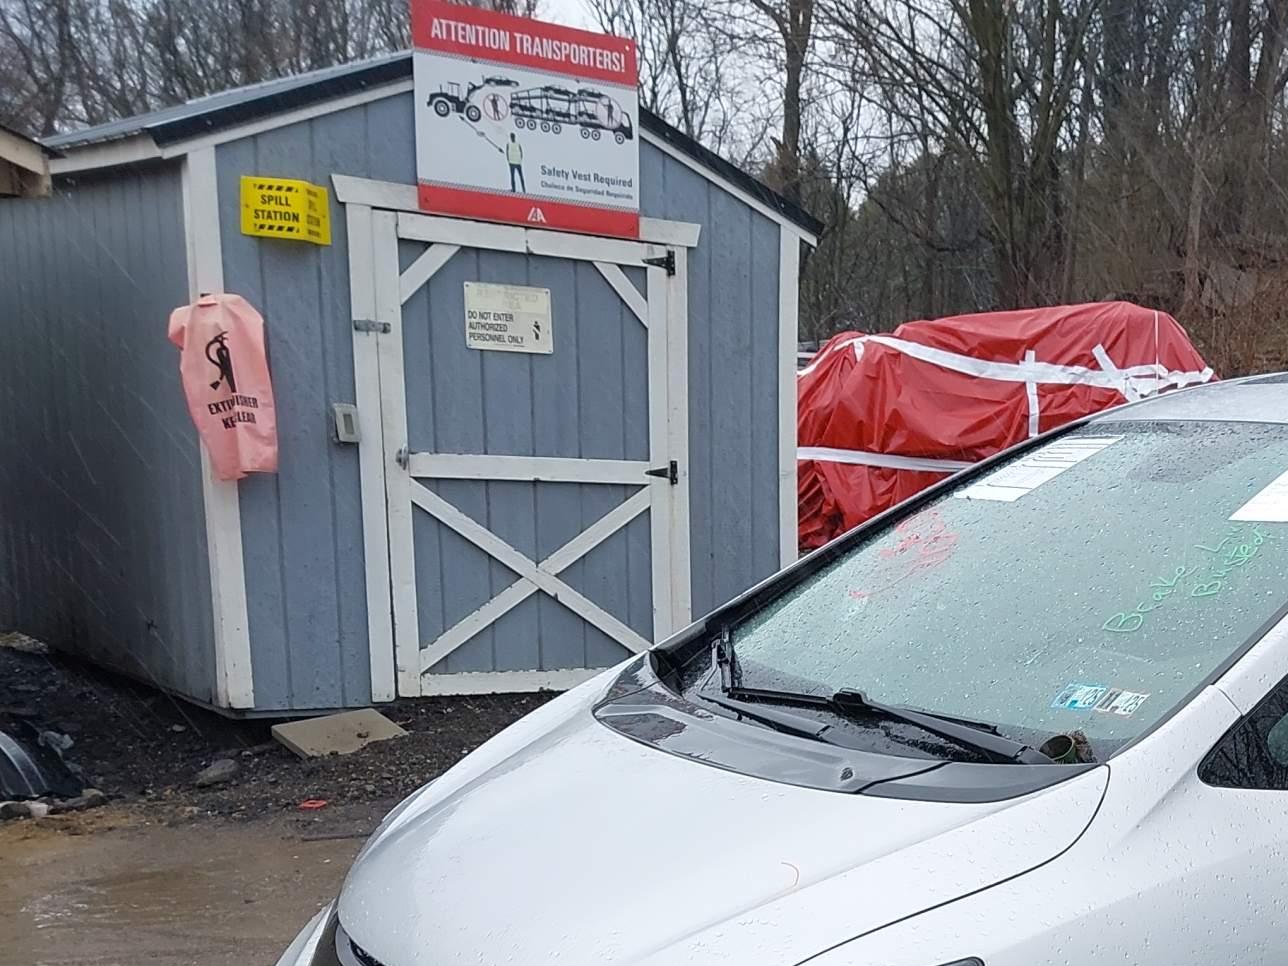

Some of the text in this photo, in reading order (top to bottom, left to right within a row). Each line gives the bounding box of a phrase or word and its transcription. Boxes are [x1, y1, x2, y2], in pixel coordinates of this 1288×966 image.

[430, 17, 626, 73] ATTENTION TRANSPORTERS!
[541, 164, 633, 188] Safety Vest Required
[260, 194, 291, 207] SPILL
[254, 208, 300, 223] STATION
[468, 310, 514, 322] DO NOT ENTER
[468, 321, 508, 333] AUTHORIZED
[468, 332, 524, 344] PERSONNEL ONLY
